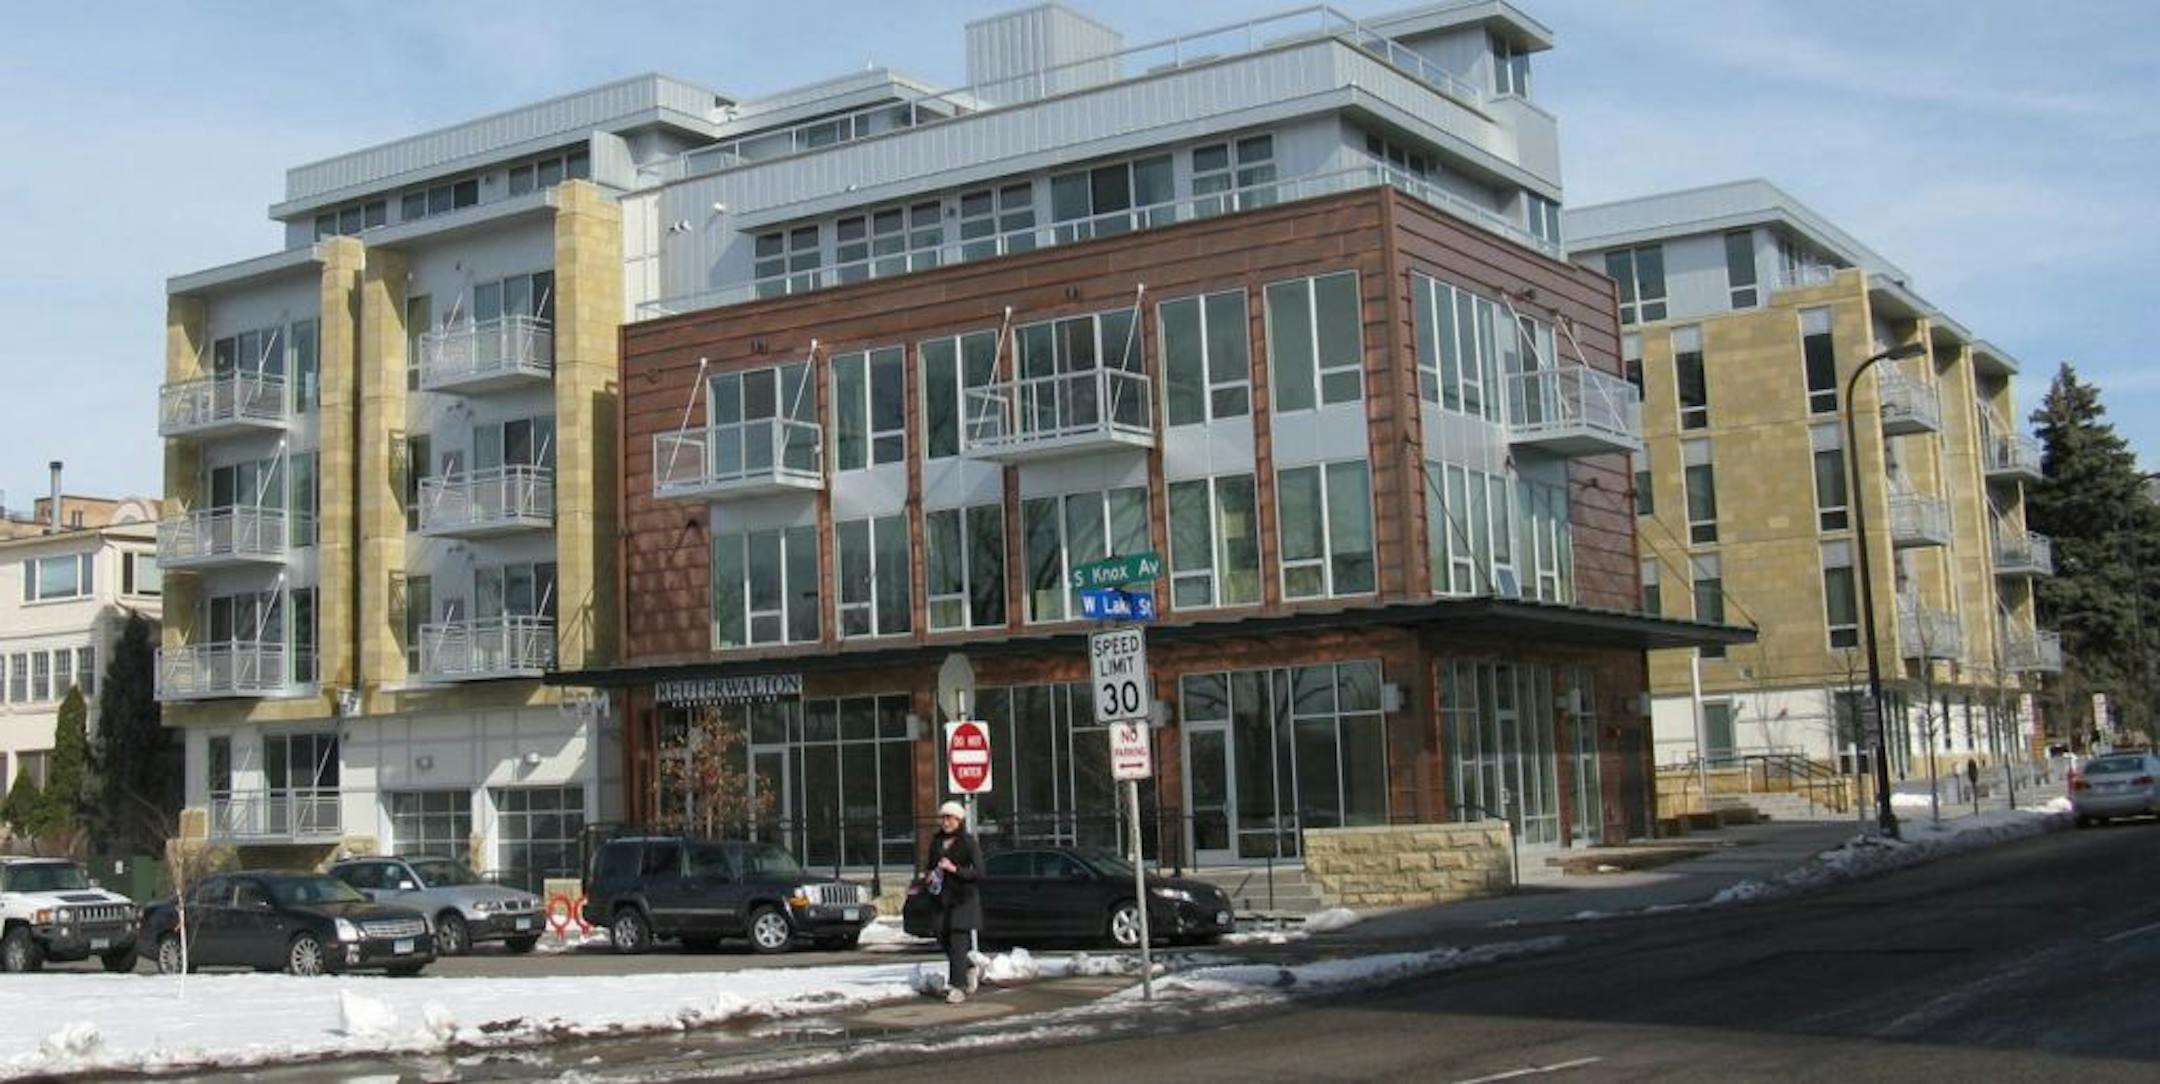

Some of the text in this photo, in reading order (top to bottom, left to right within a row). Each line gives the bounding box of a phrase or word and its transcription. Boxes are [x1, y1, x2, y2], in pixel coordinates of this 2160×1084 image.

[1074, 559, 1159, 587] S Knox Av
[1083, 597, 1096, 613] W
[1094, 636, 1139, 656] SPEED
[1100, 657, 1135, 676] LIMIT
[1103, 681, 1139, 715] 30
[953, 734, 965, 747] DO
[1121, 727, 1138, 744] NO
